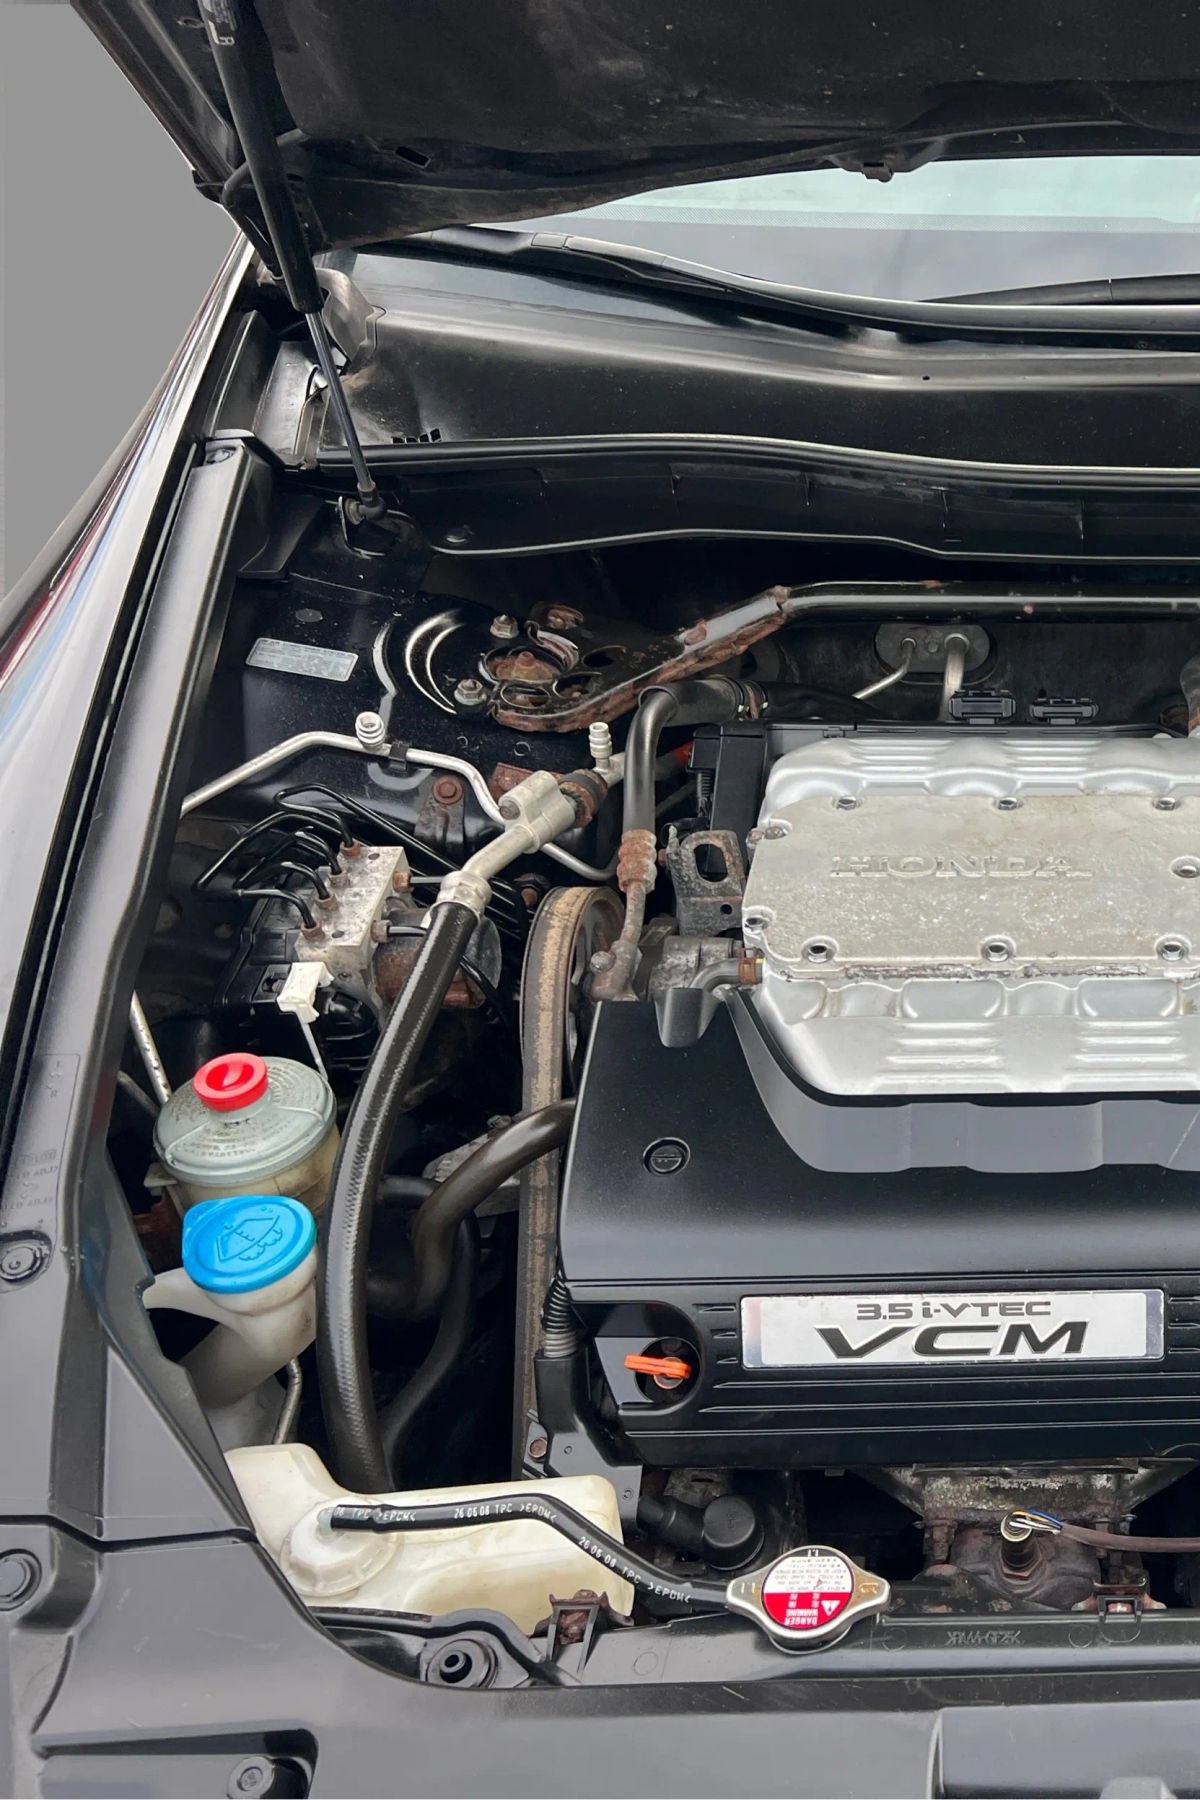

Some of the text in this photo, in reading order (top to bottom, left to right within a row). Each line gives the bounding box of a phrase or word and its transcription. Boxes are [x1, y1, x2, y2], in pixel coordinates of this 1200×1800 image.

[830, 856, 1094, 879] HONDA
[856, 1301, 1051, 1320] 3.5 i-VTEC
[814, 1320, 1091, 1359] VCM
[494, 1503, 513, 1515] TPC
[621, 1566, 643, 1585] TPC
[784, 1616, 818, 1626] DANGER
